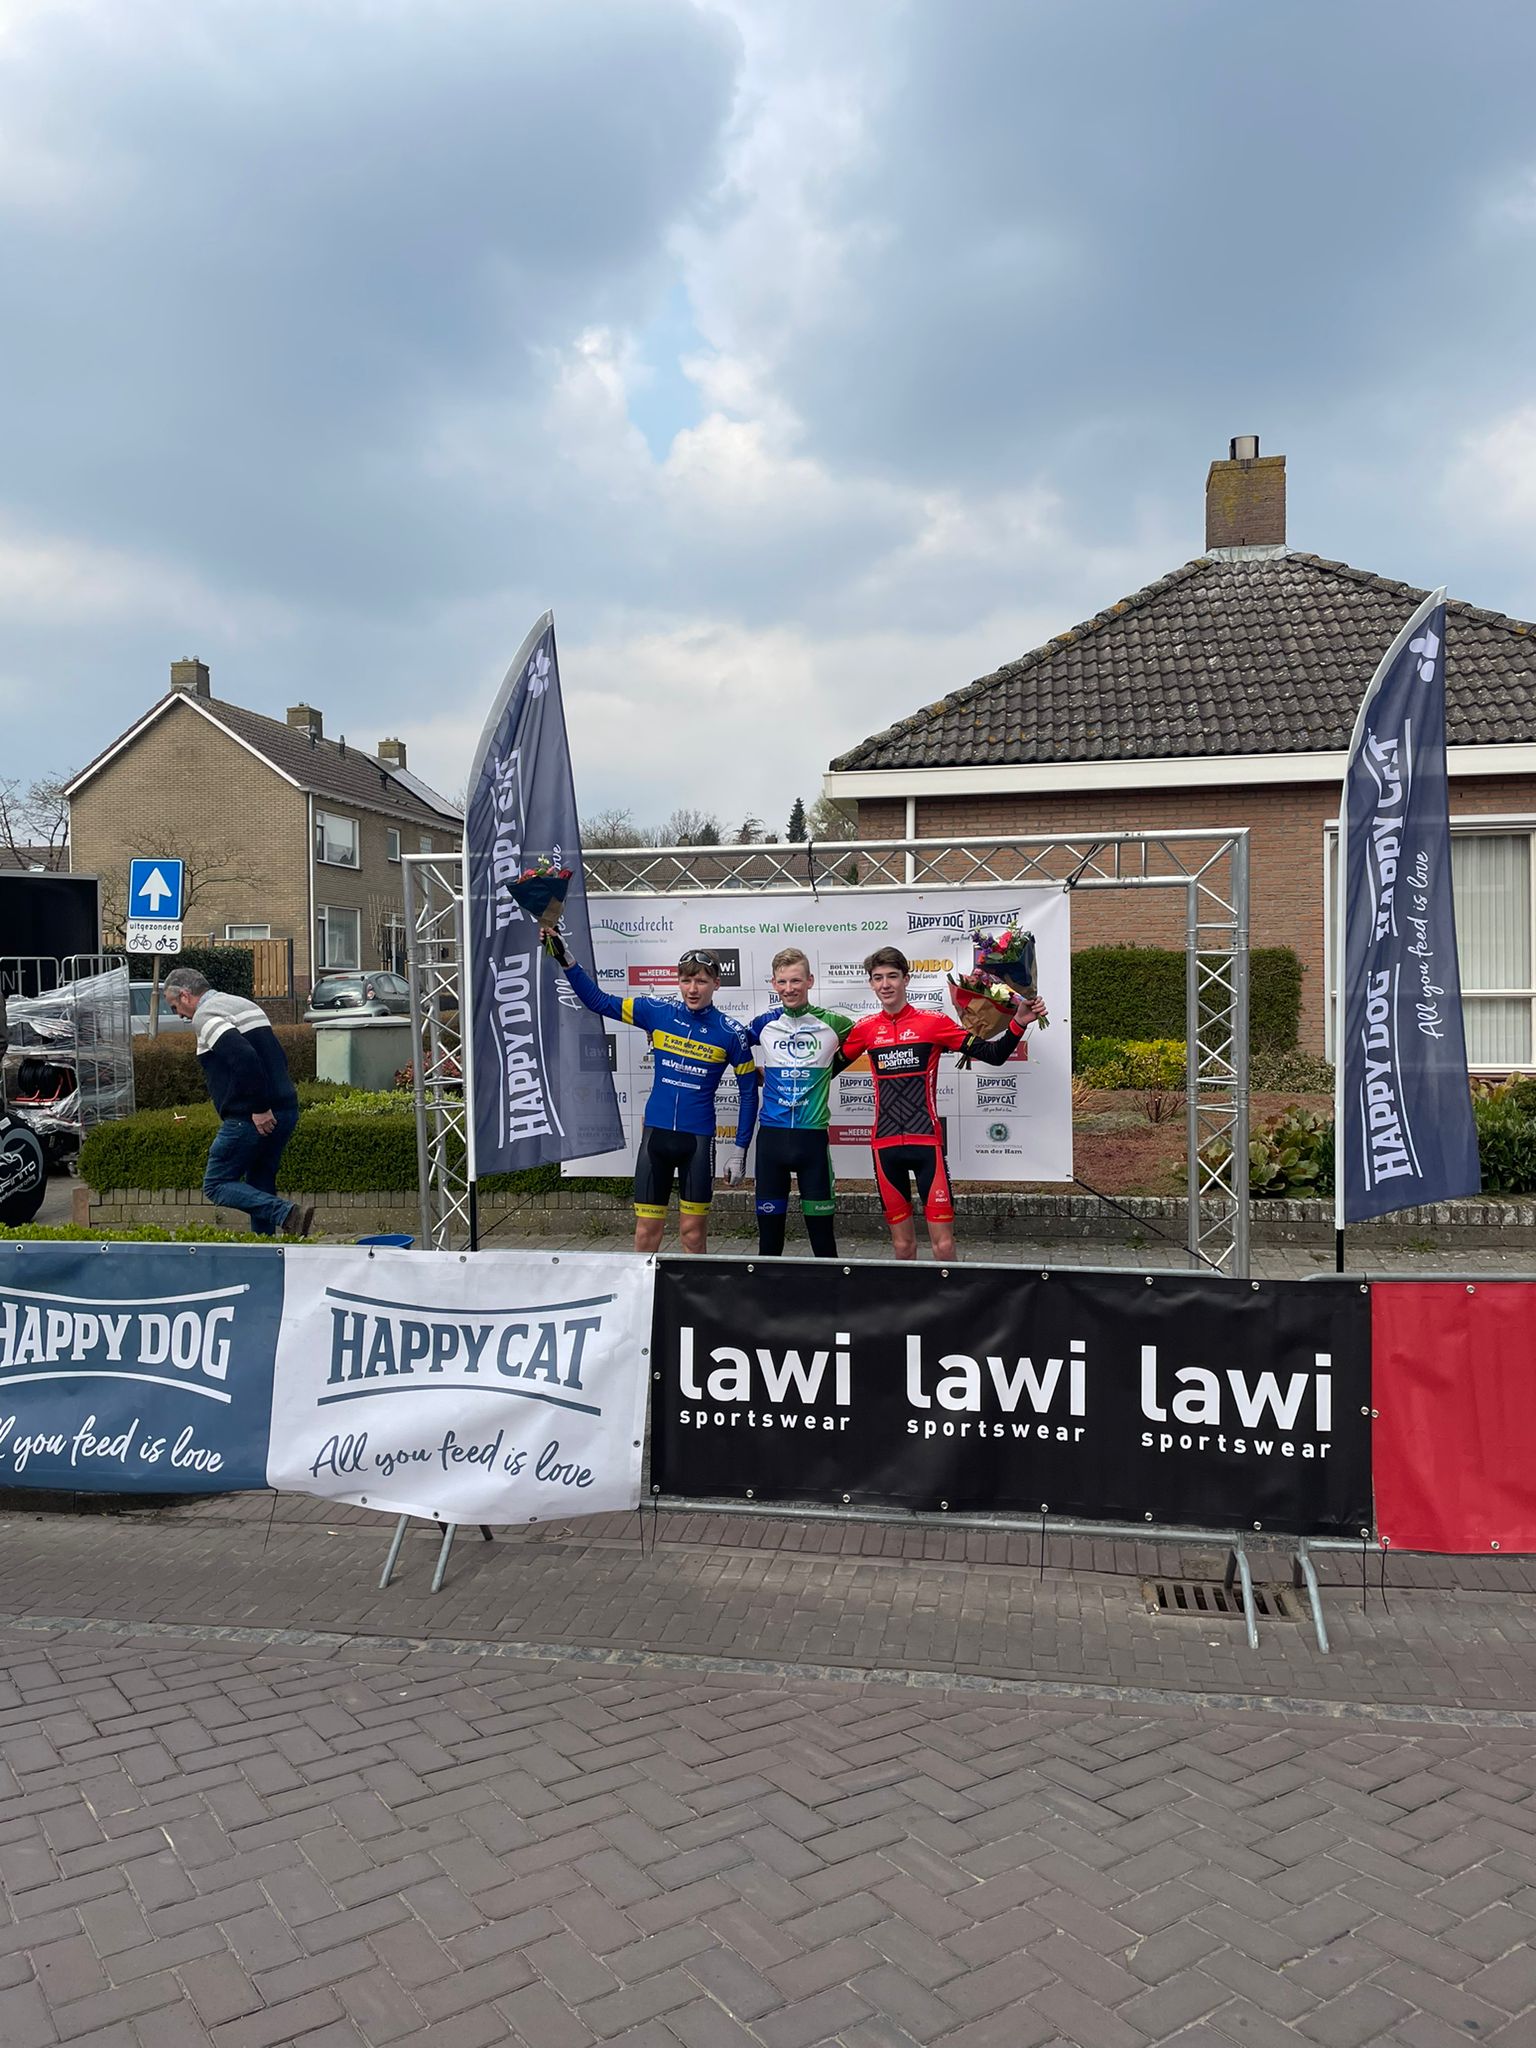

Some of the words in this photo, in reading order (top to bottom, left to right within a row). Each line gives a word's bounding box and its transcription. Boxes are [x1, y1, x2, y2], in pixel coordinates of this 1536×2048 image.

[1406, 850, 1430, 890] love
[1413, 891, 1428, 912] is
[130, 922, 179, 932] uitgezonderd
[601, 916, 674, 932] Woensdrecht
[699, 923, 756, 934] Brabantse
[759, 923, 780, 933] Wal
[783, 922, 857, 932] Wielerevents
[861, 921, 888, 931] 2022
[908, 915, 941, 930] HAPPY
[943, 914, 964, 928] DOG
[969, 913, 1000, 928] HAPPY
[1000, 912, 1019, 925] CAT
[1407, 913, 1433, 957] feed
[719, 960, 735, 972] wi
[907, 959, 953, 972] UMBO
[1419, 957, 1444, 997] you
[493, 953, 532, 1027] DOG
[906, 992, 928, 1001] HAPPY
[928, 991, 943, 1002] DOG
[716, 1002, 749, 1011] ensdrecht
[1365, 969, 1392, 1049] DOG
[1416, 1001, 1444, 1040] All
[878, 1048, 914, 1060] mulderij
[884, 1056, 920, 1069] partners
[780, 1069, 811, 1078] BOS
[840, 1078, 863, 1088] HAPPY
[977, 1078, 1000, 1088] HAPPY
[1001, 1078, 1017, 1088] DOG
[503, 1032, 554, 1142] HAPPY
[840, 1095, 863, 1105] HAPPY
[977, 1095, 1001, 1105] HAPPY
[1001, 1095, 1016, 1105] CAT
[1364, 1052, 1414, 1184] HAPPY
[138, 1306, 236, 1381] DOG
[327, 1306, 495, 1386] HAPPY
[499, 1316, 602, 1390] CAT
[679, 1326, 851, 1406] lawi
[906, 1335, 1087, 1417] lawi
[1140, 1345, 1332, 1432] lawi
[679, 1406, 850, 1432] sportswear
[906, 1415, 1086, 1443] sportswear
[13, 1433, 67, 1473] you
[72, 1415, 140, 1468] feed
[141, 1435, 164, 1463] is
[170, 1425, 225, 1473] love
[1140, 1430, 1332, 1459] sportswear
[308, 1432, 371, 1479] All
[375, 1446, 432, 1479] you
[438, 1429, 505, 1470] feed
[504, 1449, 527, 1477] is
[535, 1447, 596, 1488] love
